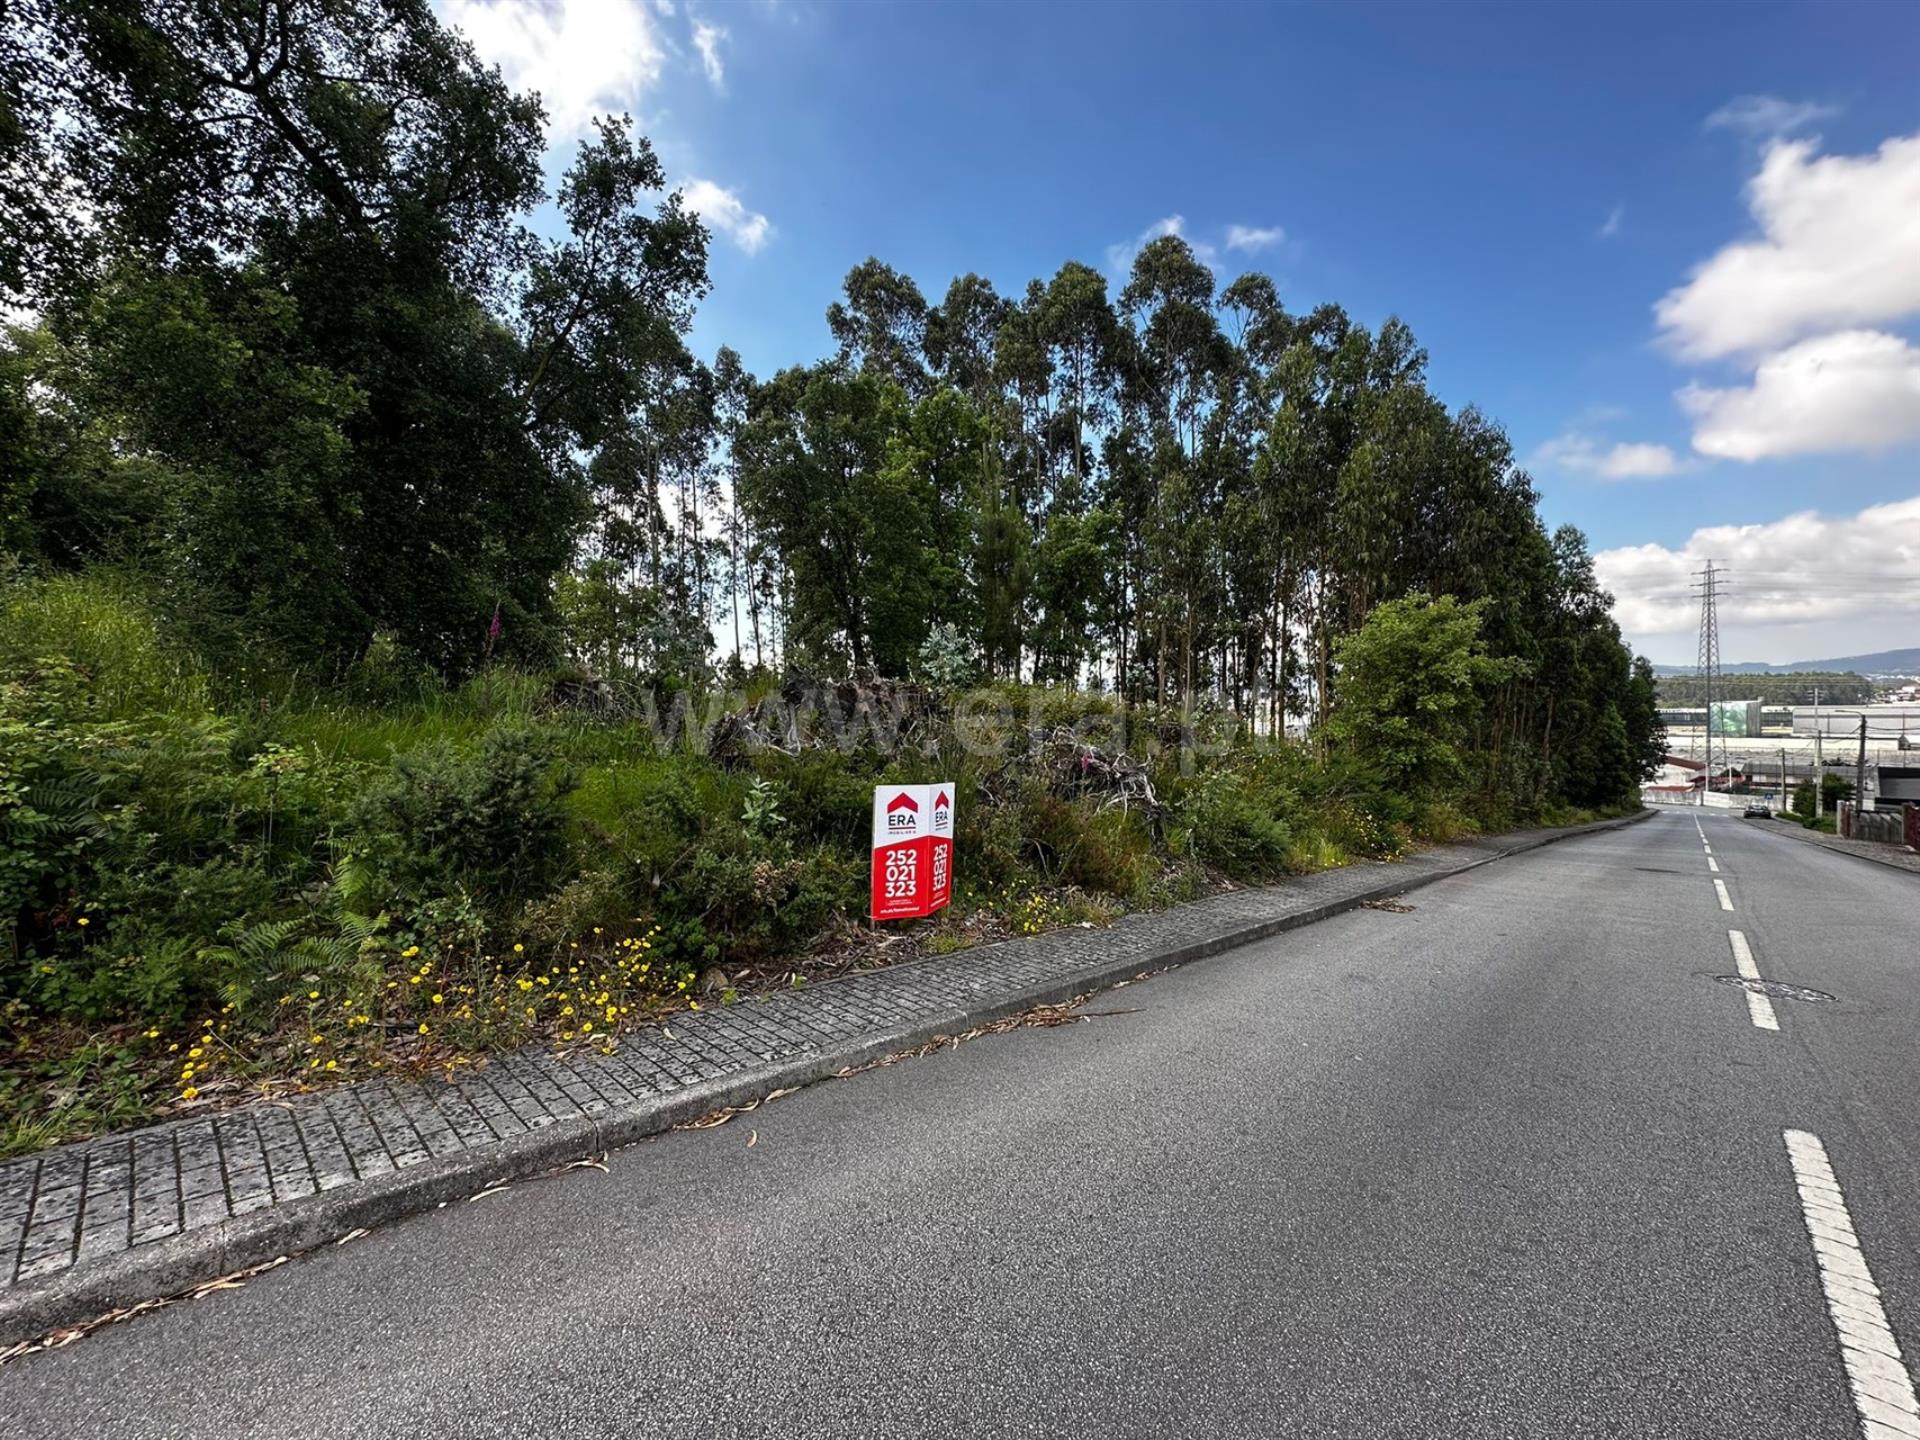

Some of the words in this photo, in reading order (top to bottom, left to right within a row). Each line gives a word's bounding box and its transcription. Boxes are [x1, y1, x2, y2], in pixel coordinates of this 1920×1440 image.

[888, 814, 916, 826] ERA
[935, 811, 948, 823] ERA
[885, 849, 917, 866] 252
[934, 844, 948, 861] 252
[886, 865, 916, 881] 021
[885, 880, 917, 897] 323
[932, 873, 946, 891] 323
